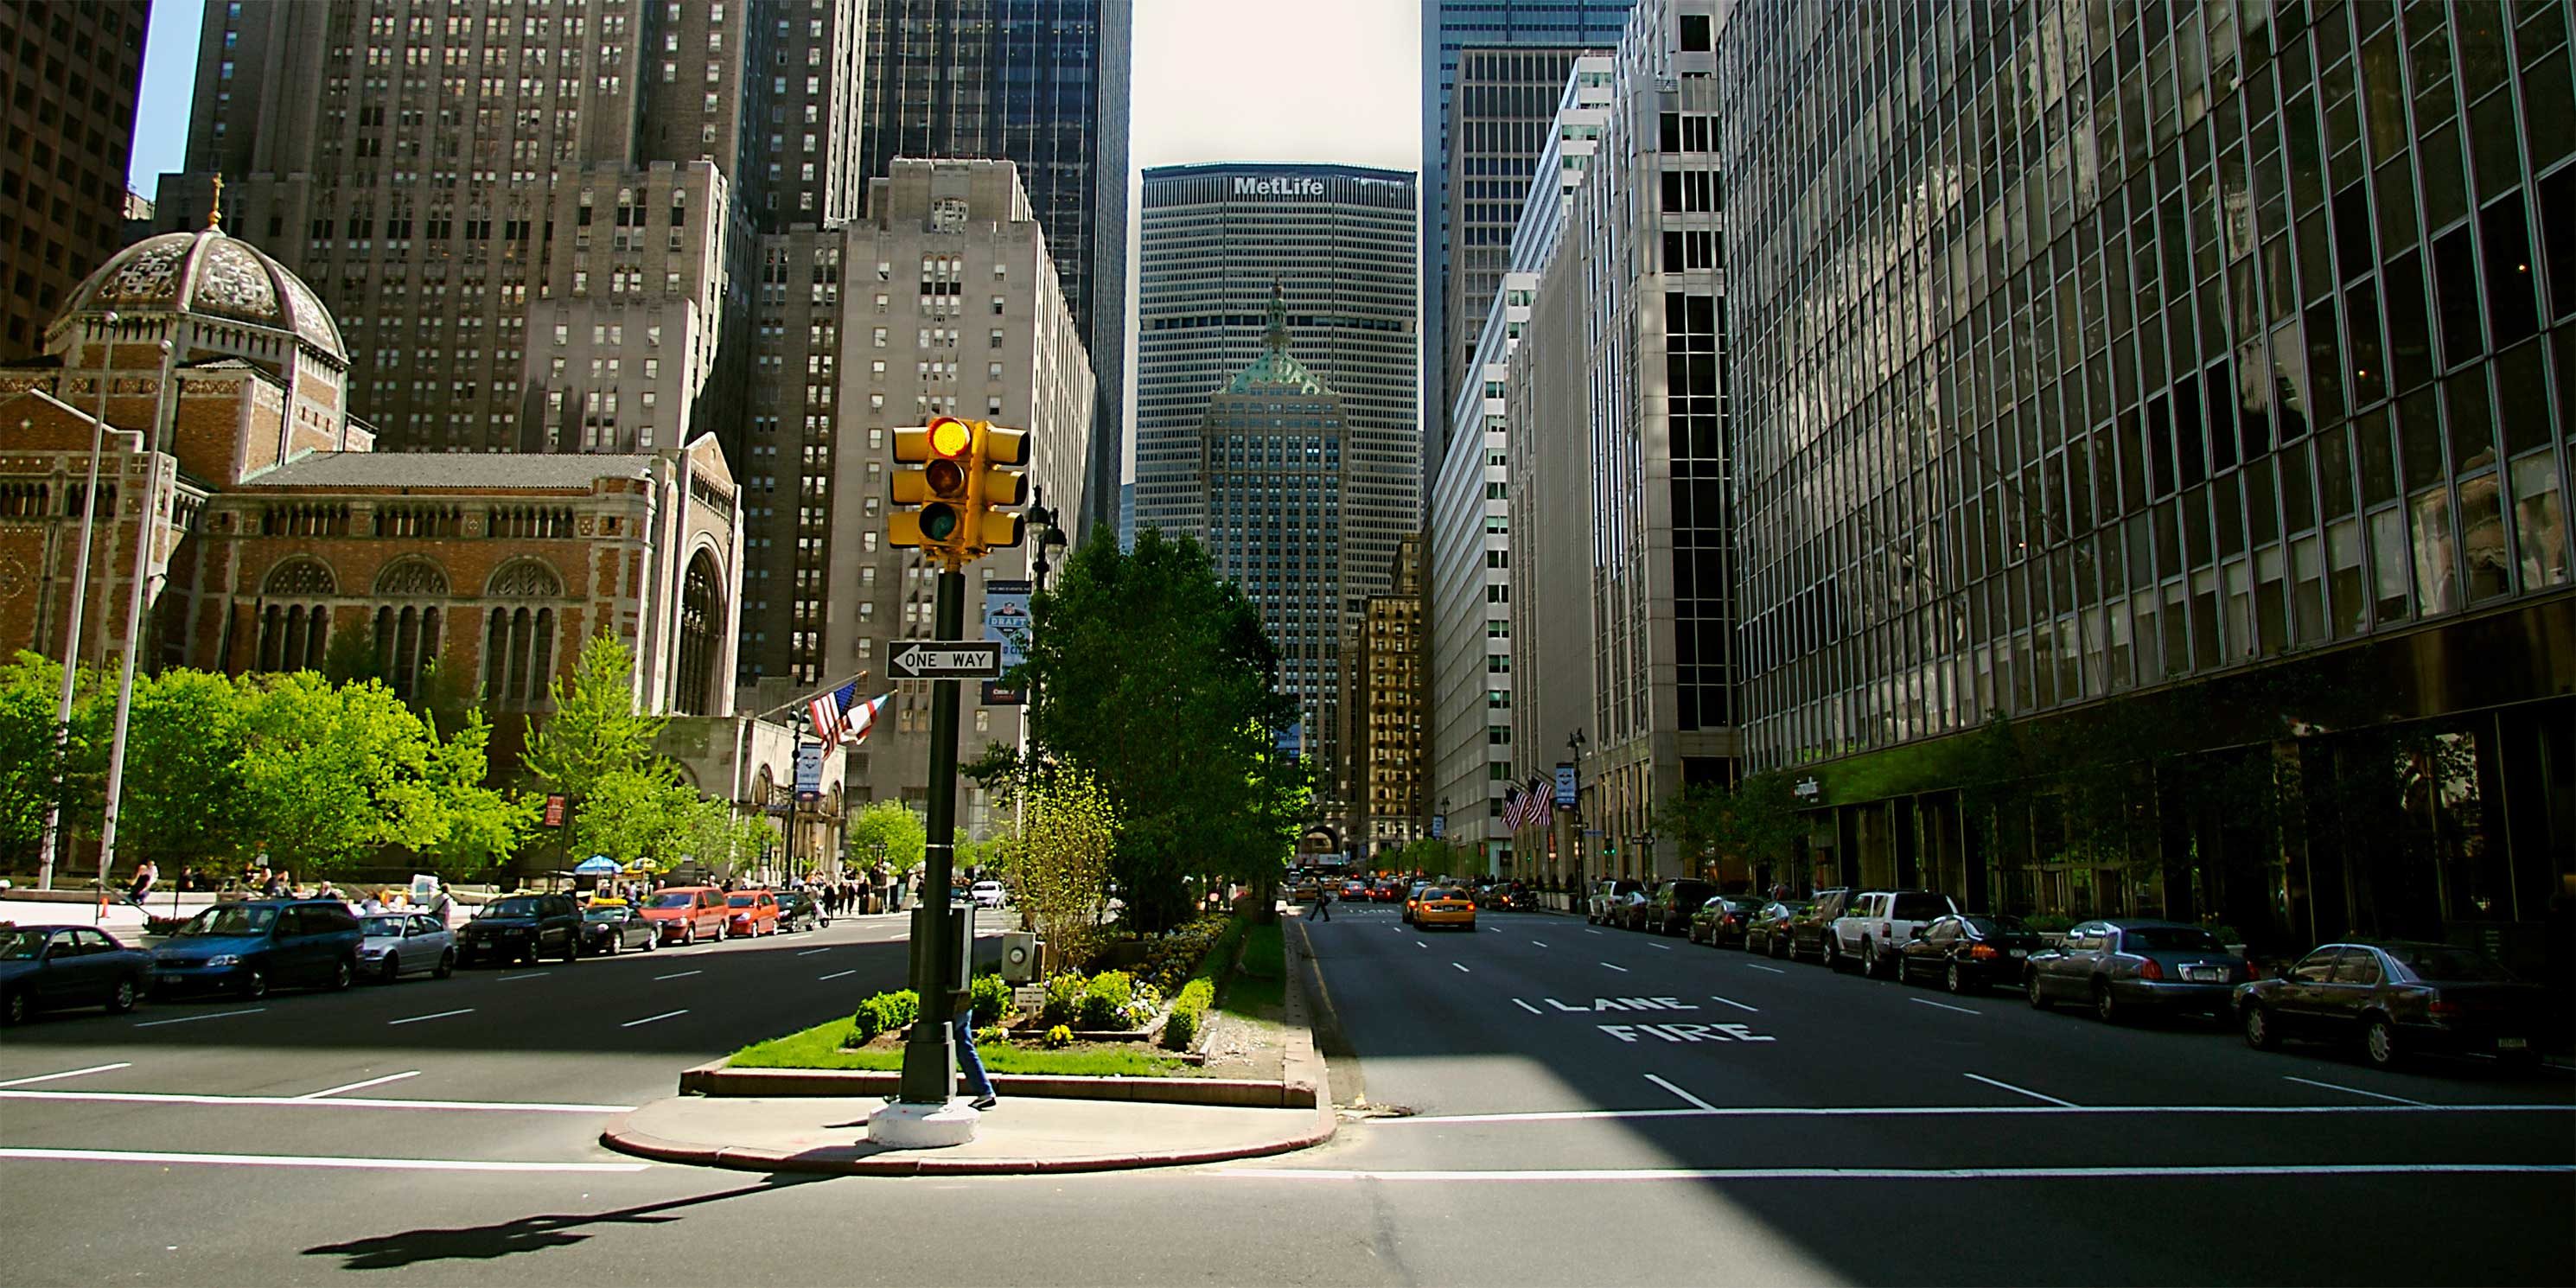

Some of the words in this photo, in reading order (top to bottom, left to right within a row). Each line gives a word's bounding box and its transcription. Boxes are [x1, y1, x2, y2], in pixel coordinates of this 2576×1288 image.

[1234, 176, 1324, 195] MetLife
[991, 617, 1027, 626] DRAFT
[905, 653, 937, 667] ONE
[953, 653, 986, 667] WAY
[1544, 998, 1700, 1011] LANE
[1597, 1023, 1777, 1042] FIRE
